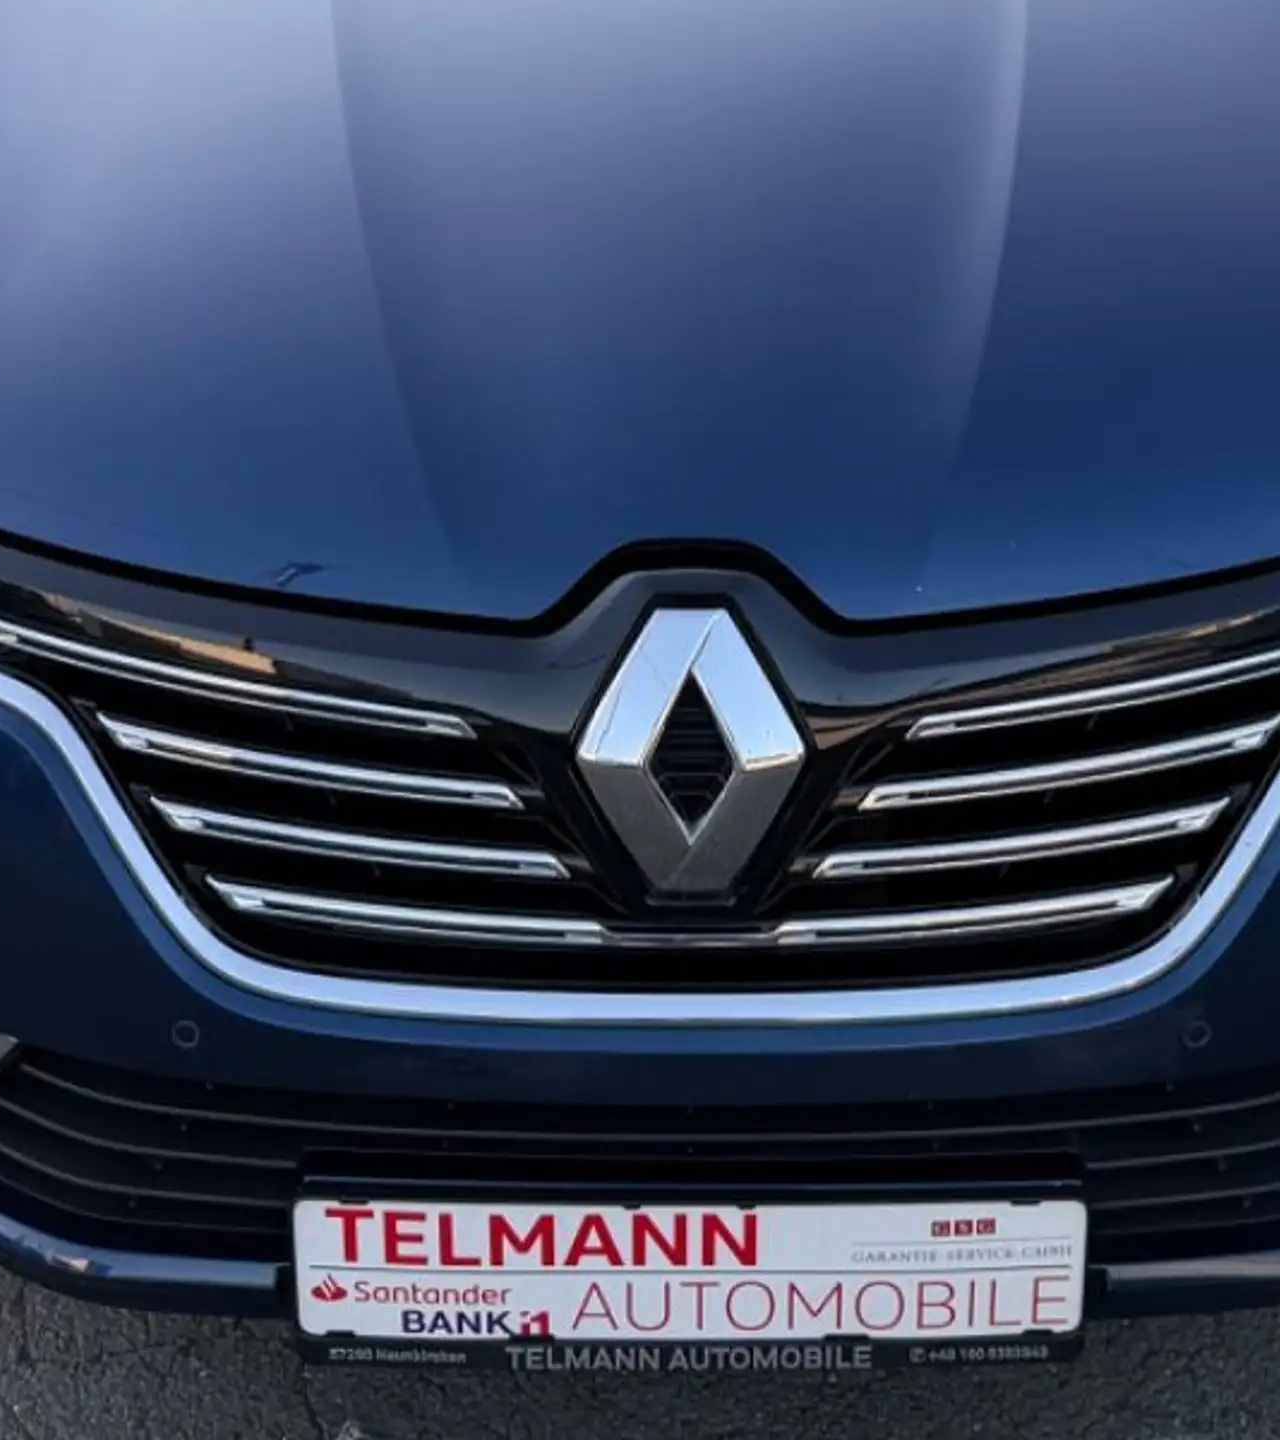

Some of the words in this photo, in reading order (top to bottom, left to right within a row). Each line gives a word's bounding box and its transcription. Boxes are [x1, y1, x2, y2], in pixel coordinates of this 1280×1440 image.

[325, 1208, 757, 1267] TELMANN
[354, 1280, 513, 1306] Santander
[572, 1275, 1071, 1332] AUTOMOBILE
[402, 1310, 514, 1335] BANK
[505, 1345, 661, 1371] TELMANN
[668, 1345, 872, 1371] AUTOMOBILE
